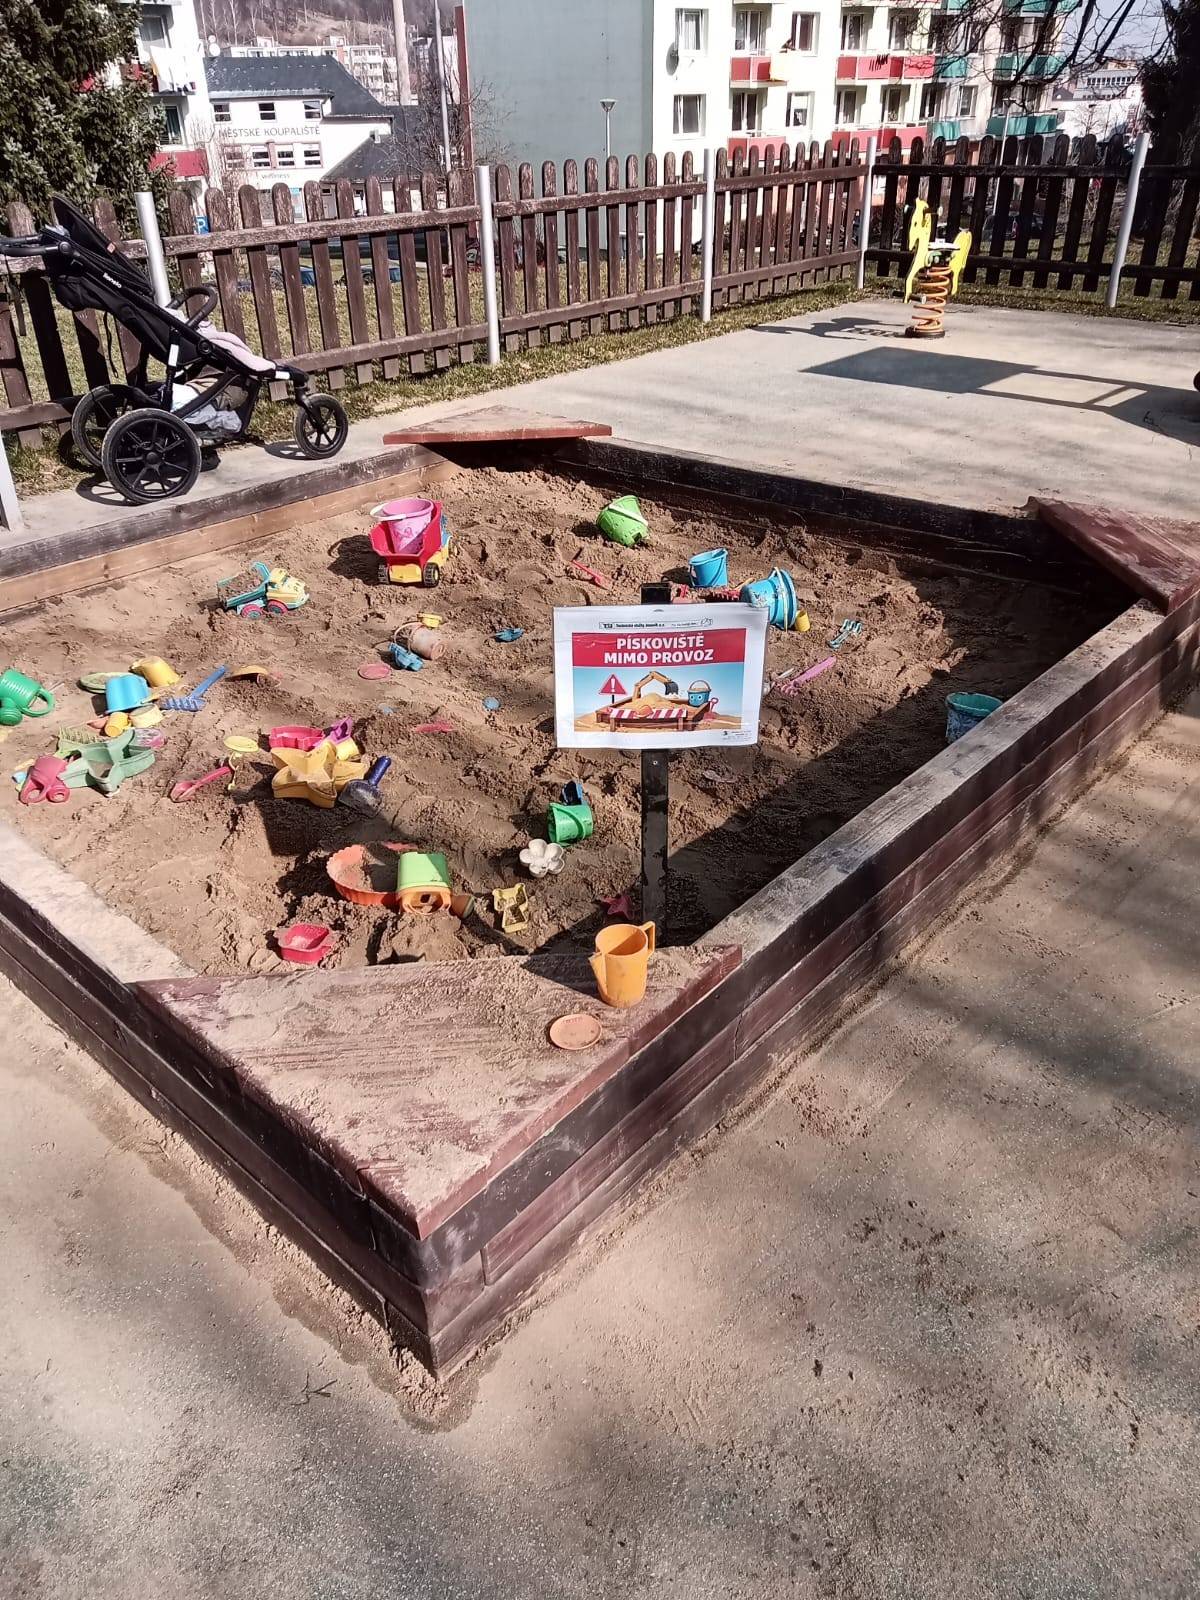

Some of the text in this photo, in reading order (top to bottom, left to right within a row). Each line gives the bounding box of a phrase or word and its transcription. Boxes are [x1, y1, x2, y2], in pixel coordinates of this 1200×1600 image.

[264, 125, 321, 137] KOUPALIŠTĚ
[616, 632, 705, 650] PÍSKOVIŠTĚ
[604, 649, 714, 664] MIMO PROVOZ
